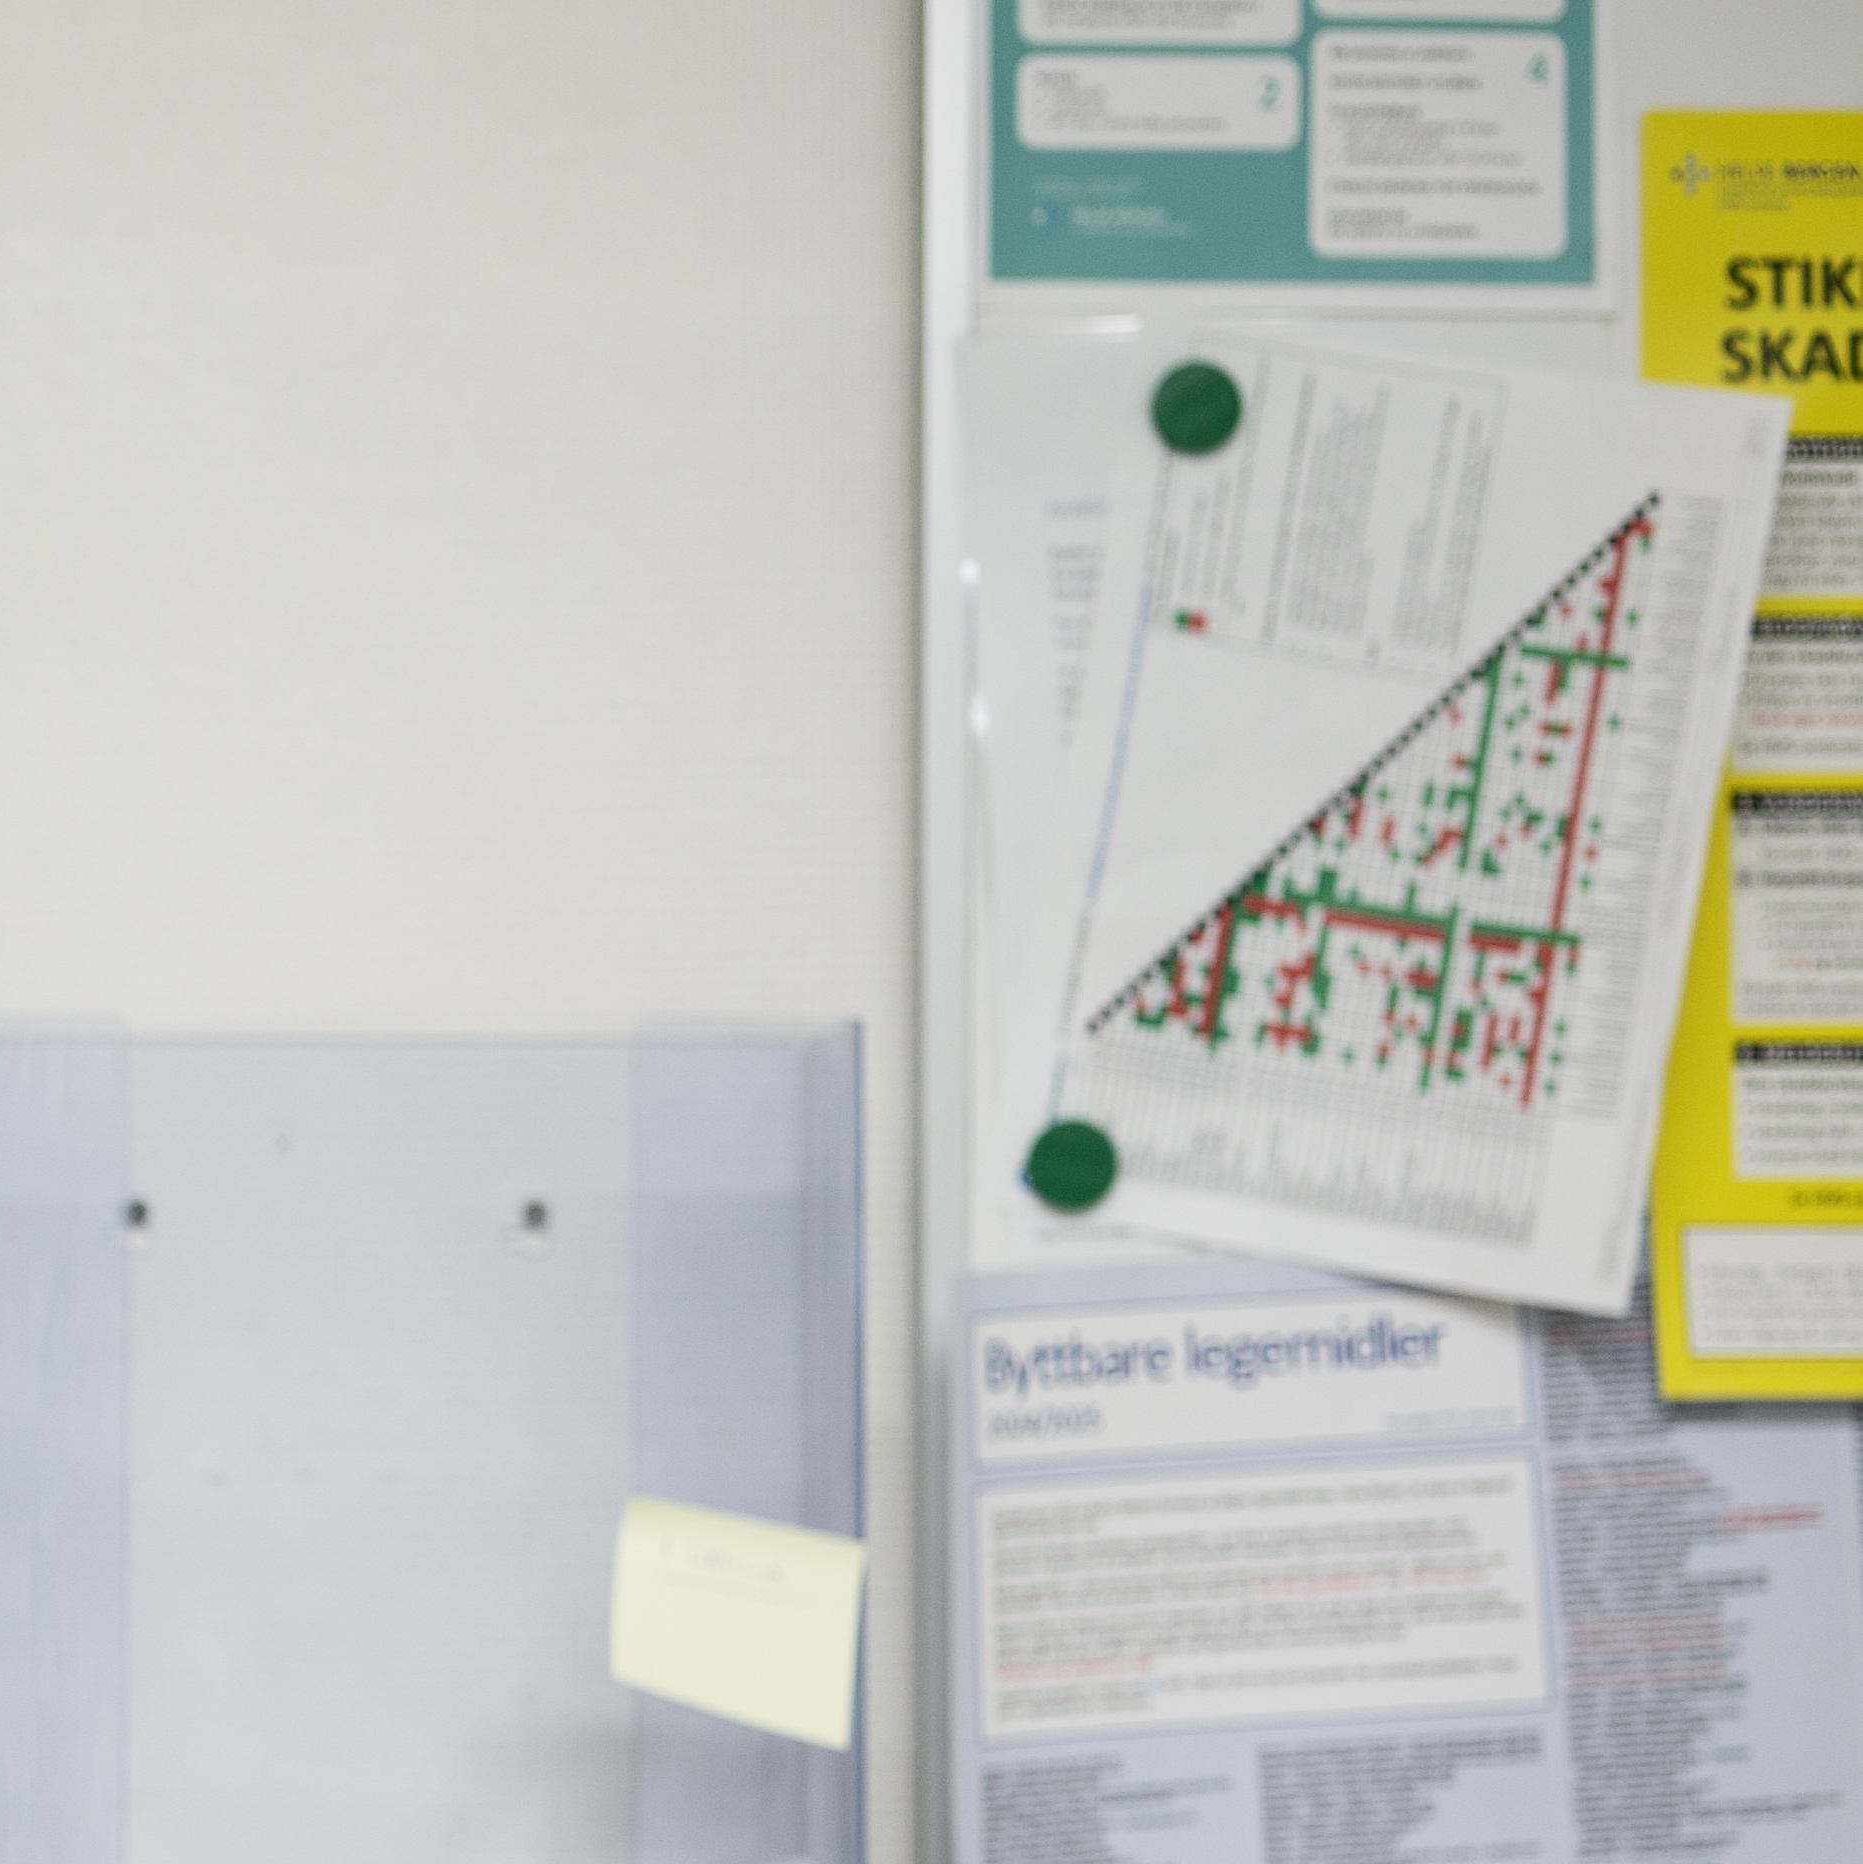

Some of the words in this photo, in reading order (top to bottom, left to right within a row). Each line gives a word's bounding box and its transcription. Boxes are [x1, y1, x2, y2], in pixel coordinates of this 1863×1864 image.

[1725, 254, 1863, 313] STIK
[984, 1330, 1172, 1397] Byttbare
[1183, 1311, 1444, 1389] legemidler
